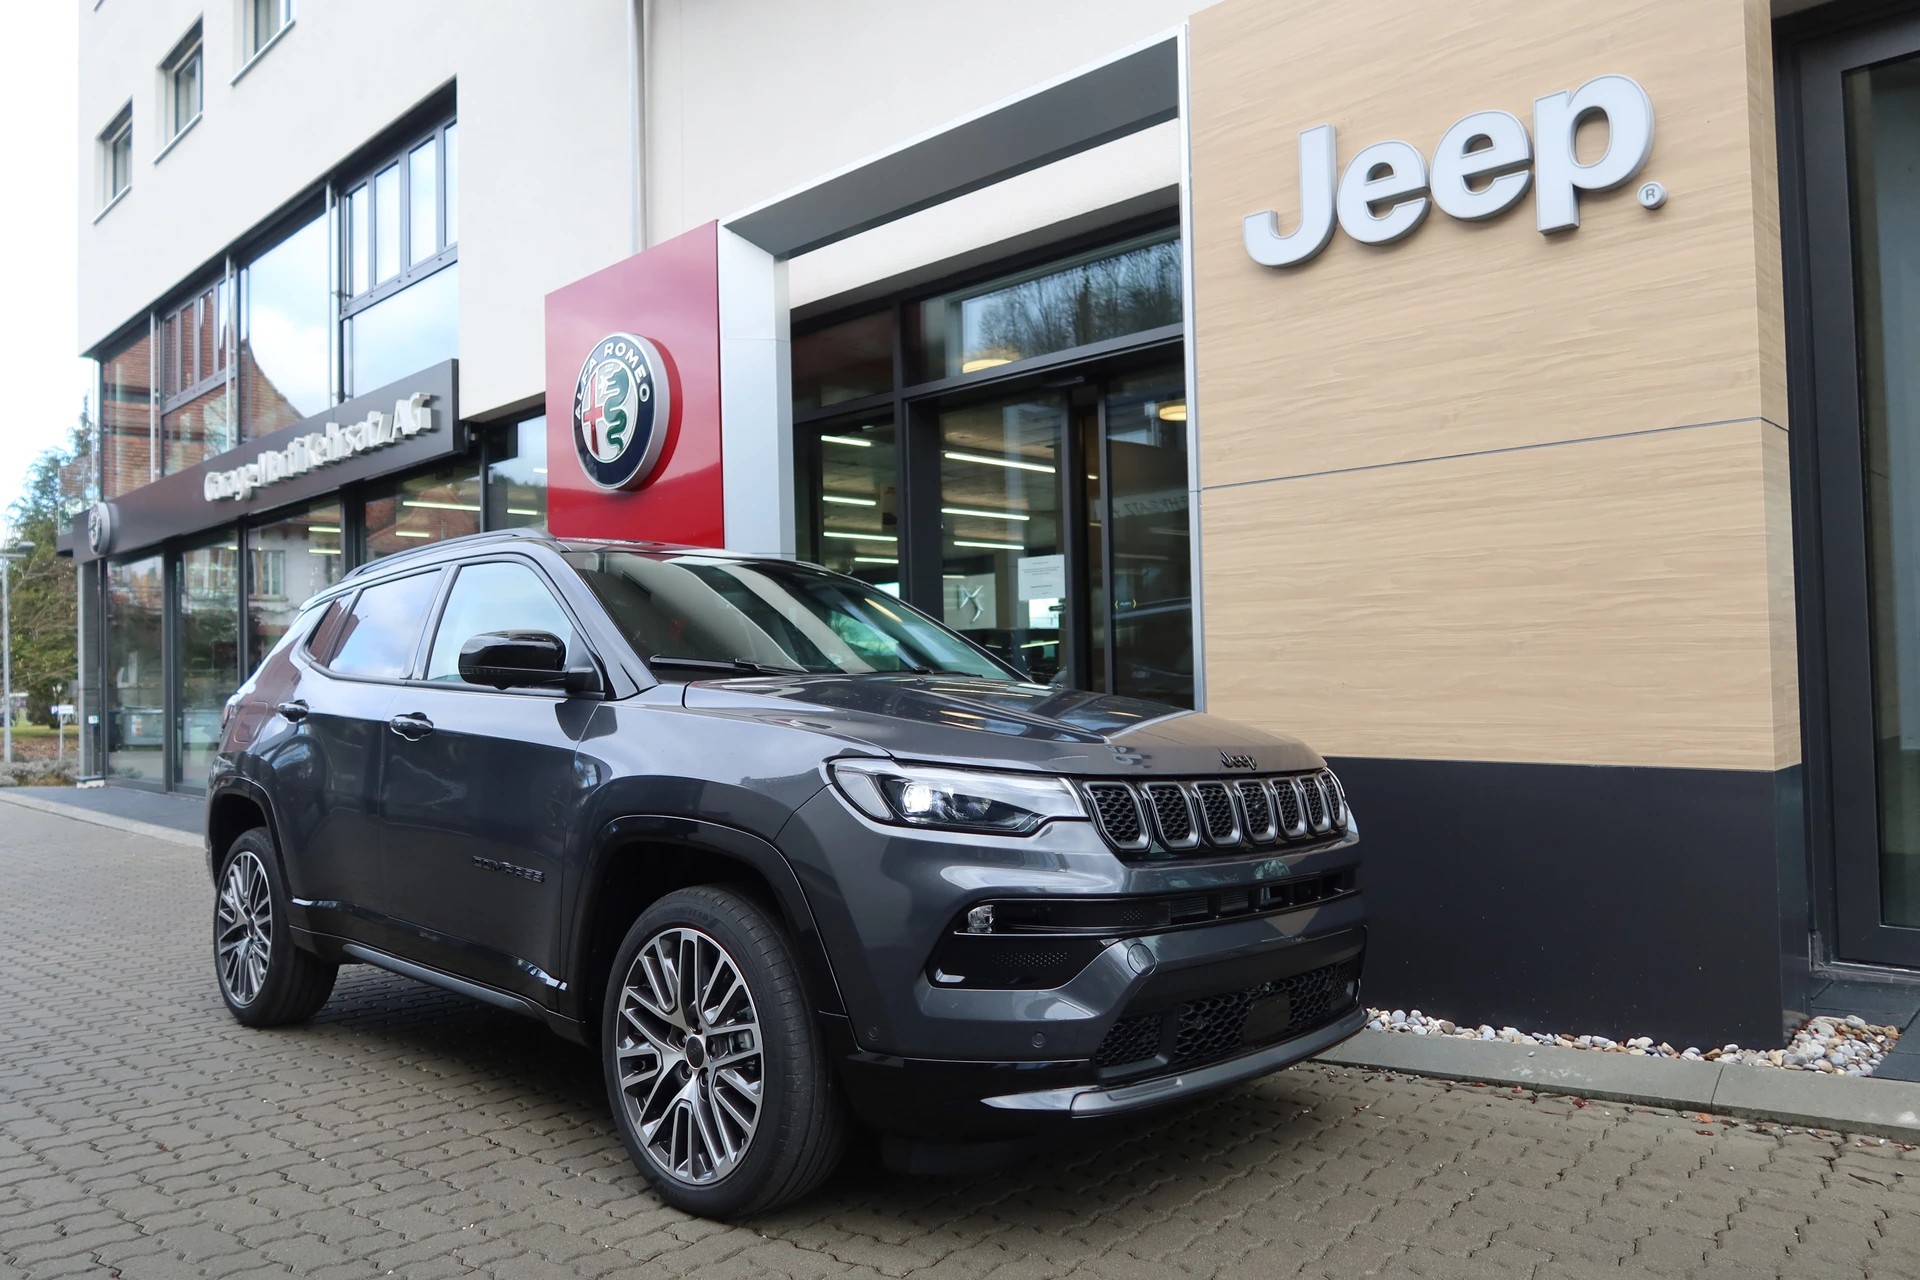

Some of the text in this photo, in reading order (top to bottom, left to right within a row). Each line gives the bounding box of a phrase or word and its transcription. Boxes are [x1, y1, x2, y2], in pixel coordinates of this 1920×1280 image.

[1243, 74, 1656, 268] Jeep
[575, 342, 650, 420] ALFA ROMEO
[391, 391, 432, 439] AG
[1221, 751, 1258, 771] Jeep
